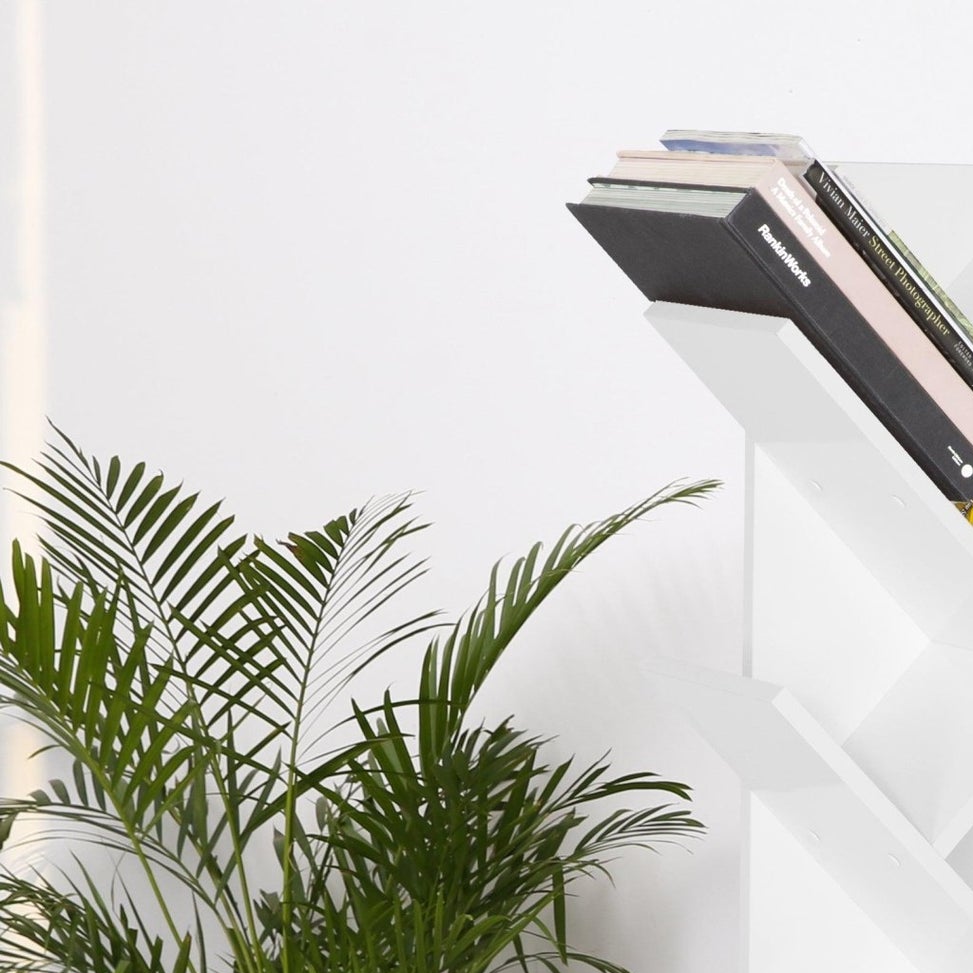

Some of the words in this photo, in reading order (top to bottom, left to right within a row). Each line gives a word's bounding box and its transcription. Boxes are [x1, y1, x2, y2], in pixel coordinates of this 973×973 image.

[756, 223, 813, 288] RankinWorks
[815, 171, 848, 208] Vivian
[843, 205, 872, 238] Maier
[867, 235, 897, 269] Street
[891, 267, 953, 337] Photographer
